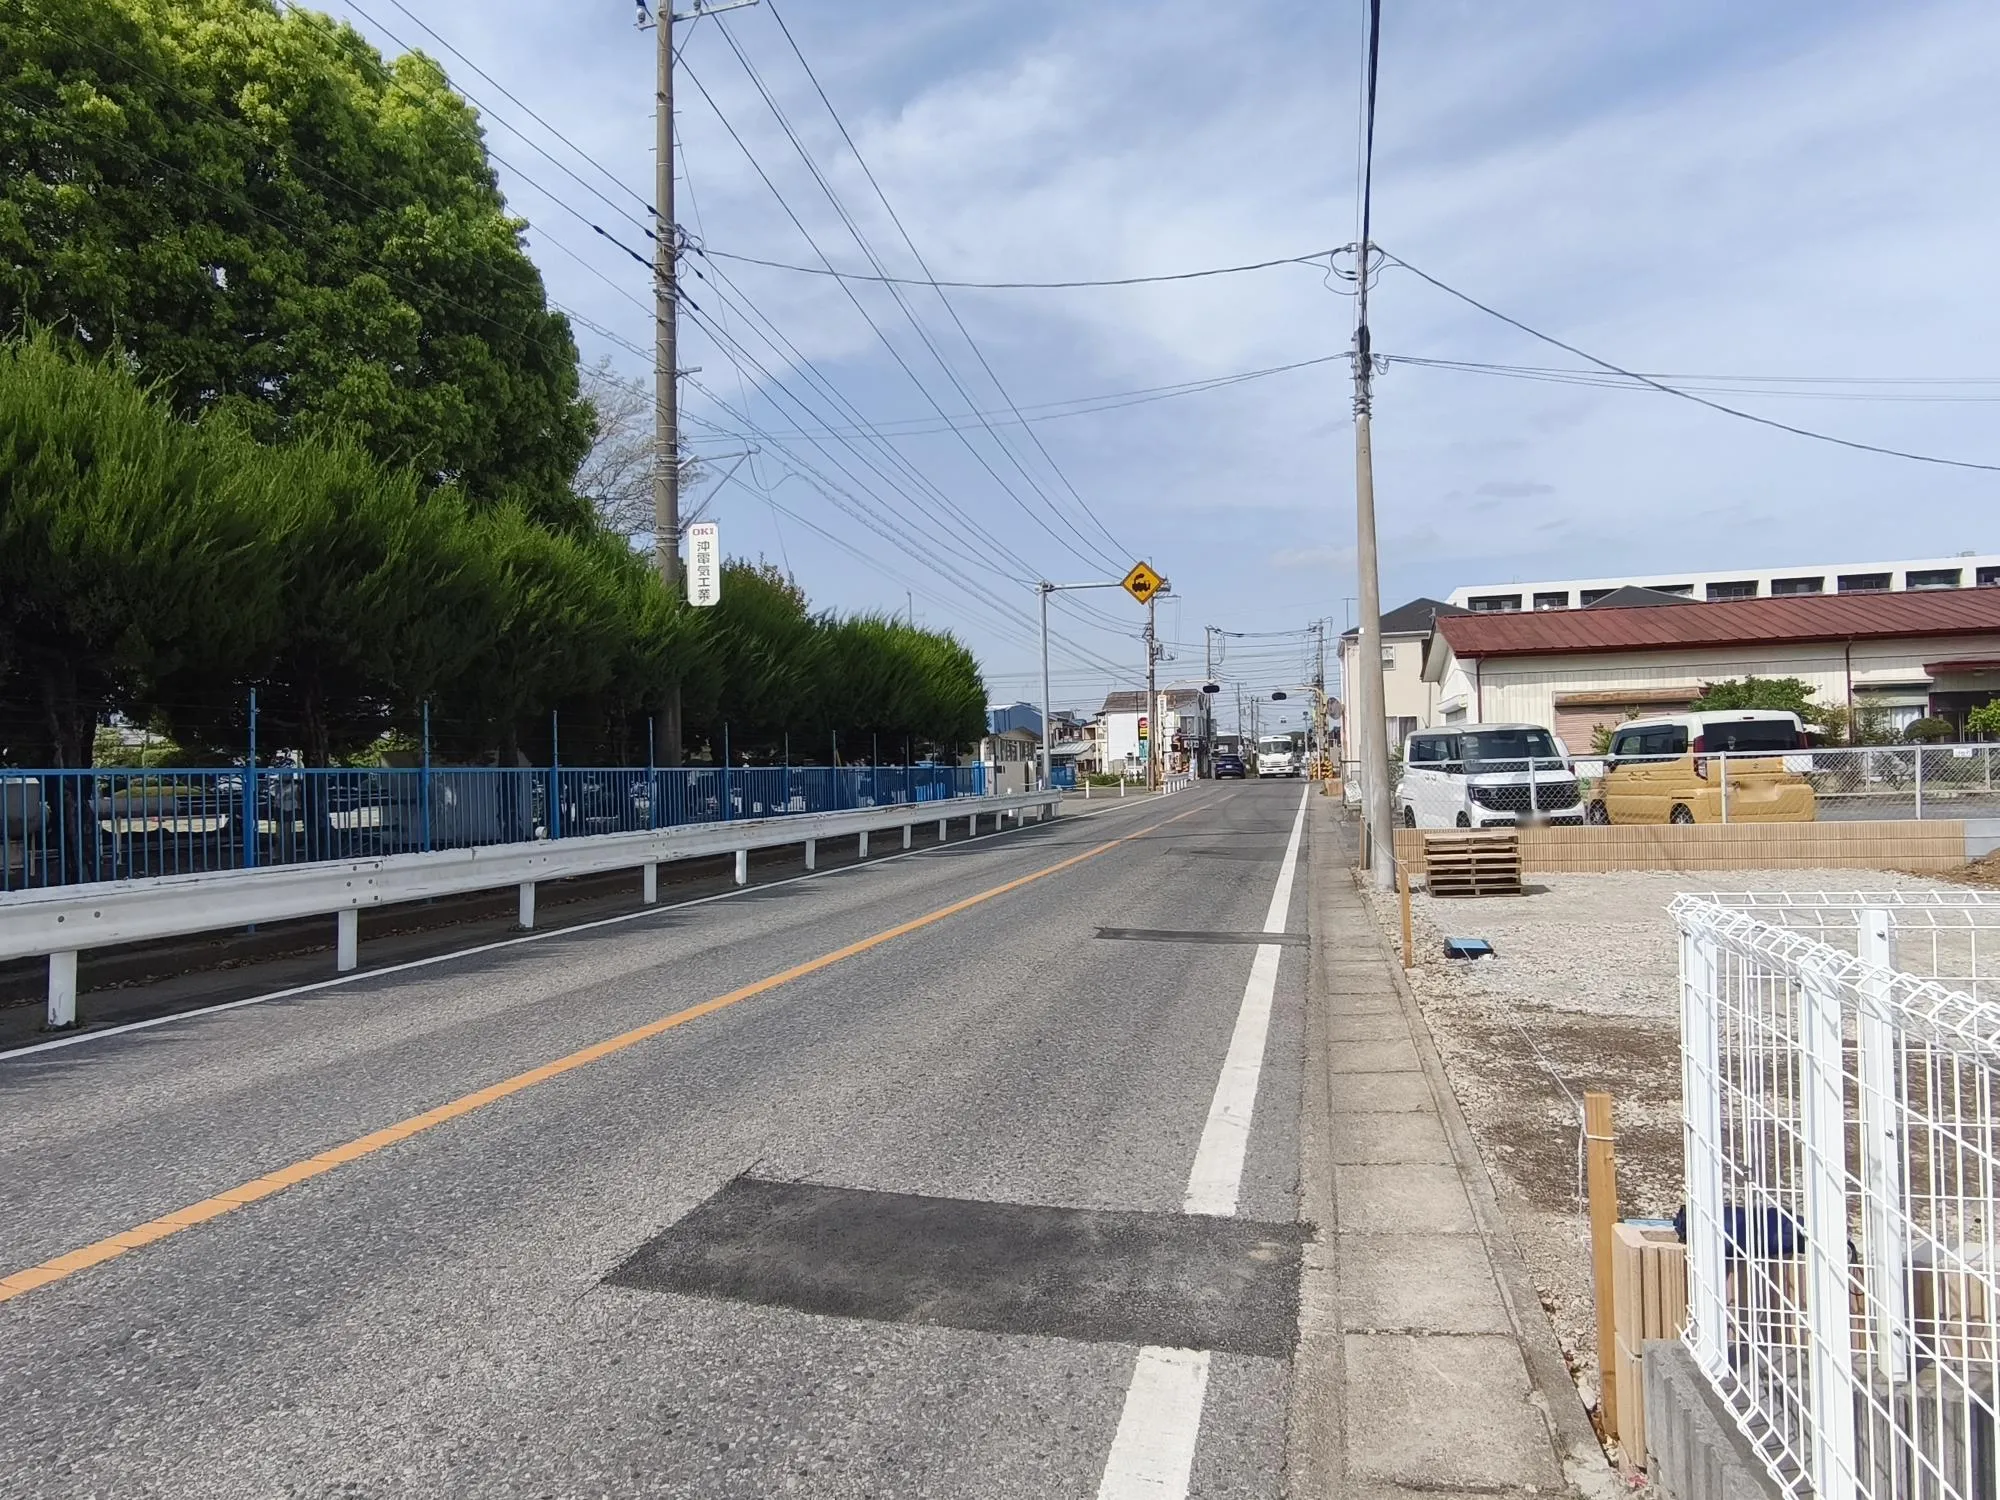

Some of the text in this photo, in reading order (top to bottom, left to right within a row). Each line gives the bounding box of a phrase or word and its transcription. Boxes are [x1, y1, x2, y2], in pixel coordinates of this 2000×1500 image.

[692, 527, 714, 536] OKI
[697, 541, 711, 601] 沖電気工業
